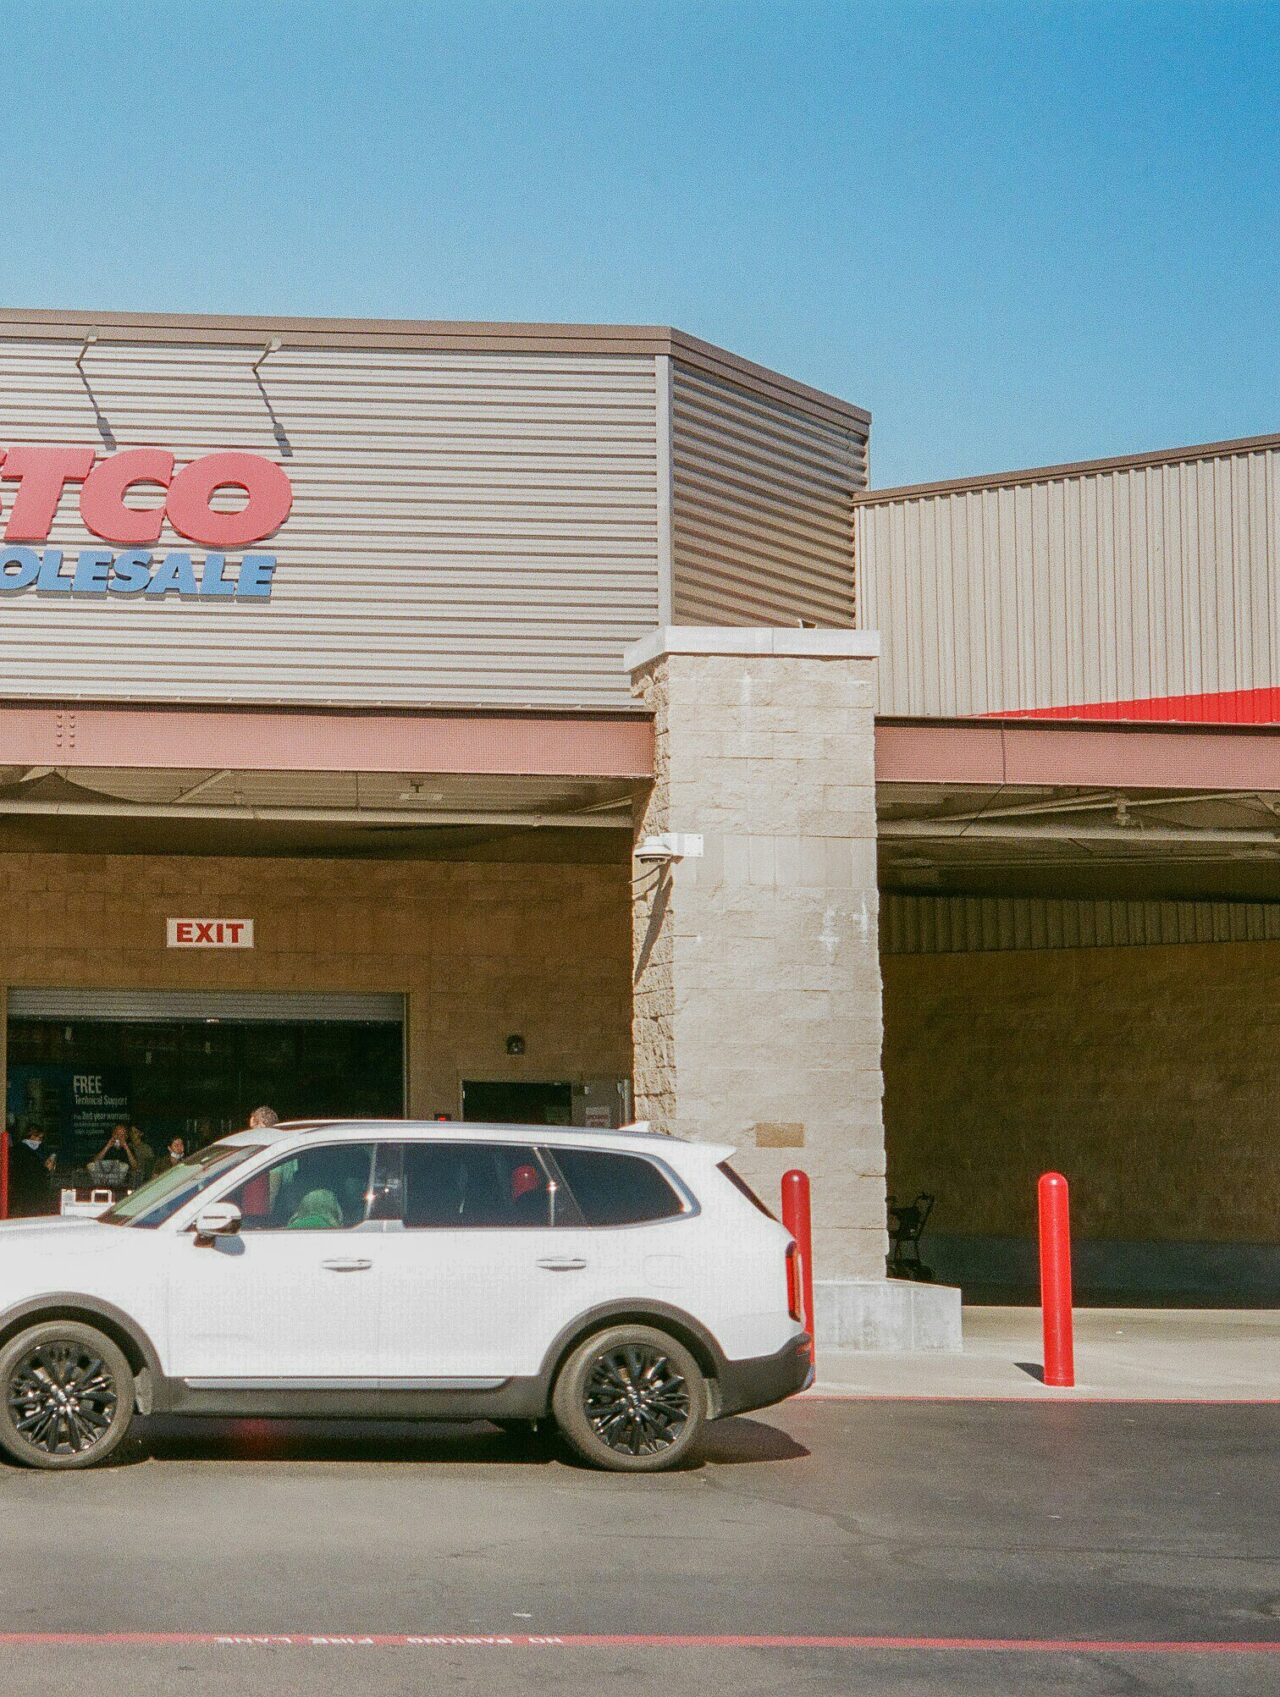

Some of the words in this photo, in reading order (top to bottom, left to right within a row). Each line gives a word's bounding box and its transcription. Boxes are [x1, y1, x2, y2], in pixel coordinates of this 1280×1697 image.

[176, 922, 244, 944] EXIT
[73, 1075, 102, 1094] FREE
[104, 1094, 128, 1108] Support
